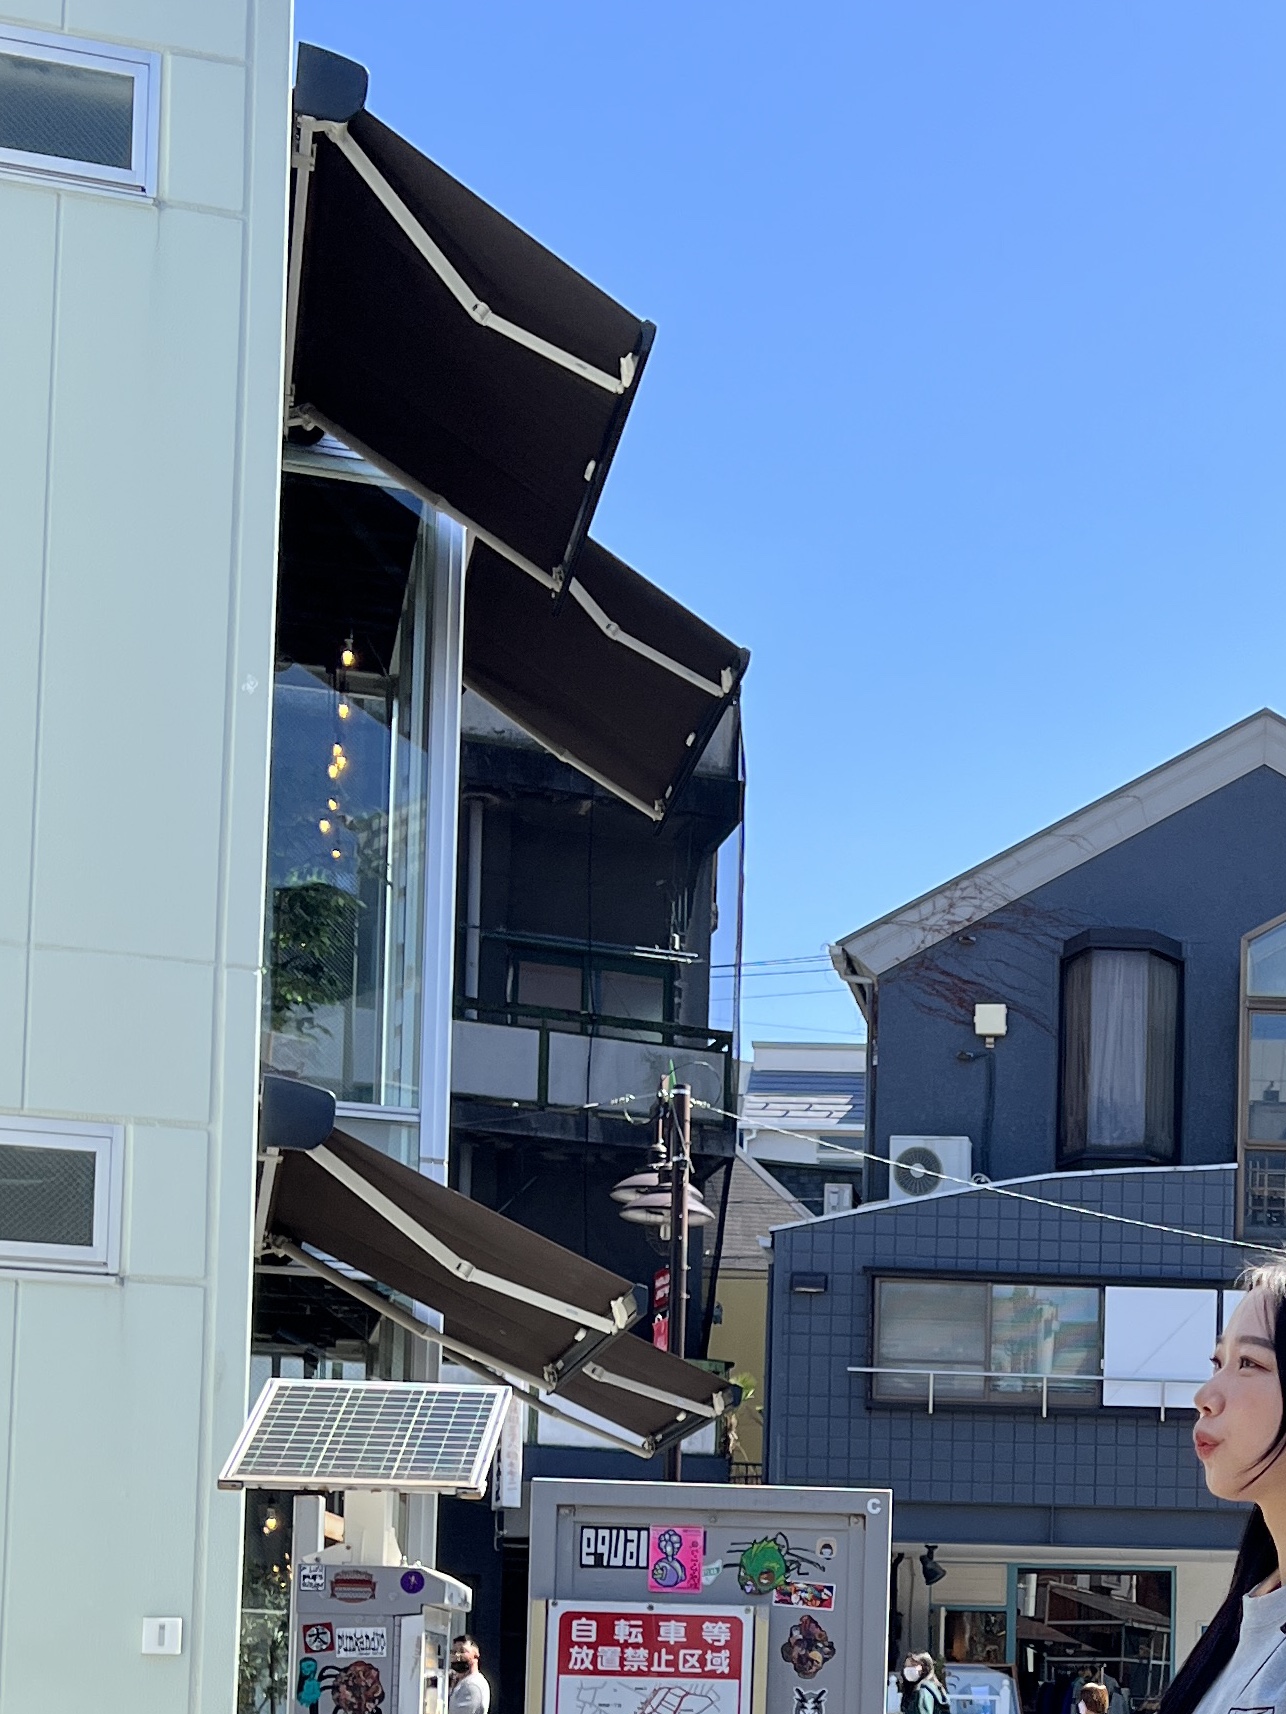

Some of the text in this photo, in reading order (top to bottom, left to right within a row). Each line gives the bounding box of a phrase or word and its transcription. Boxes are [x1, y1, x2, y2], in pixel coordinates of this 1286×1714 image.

[866, 1497, 882, 1515] C
[571, 1616, 732, 1647] 自転車等
[568, 1645, 731, 1675] 放置禁止区域
